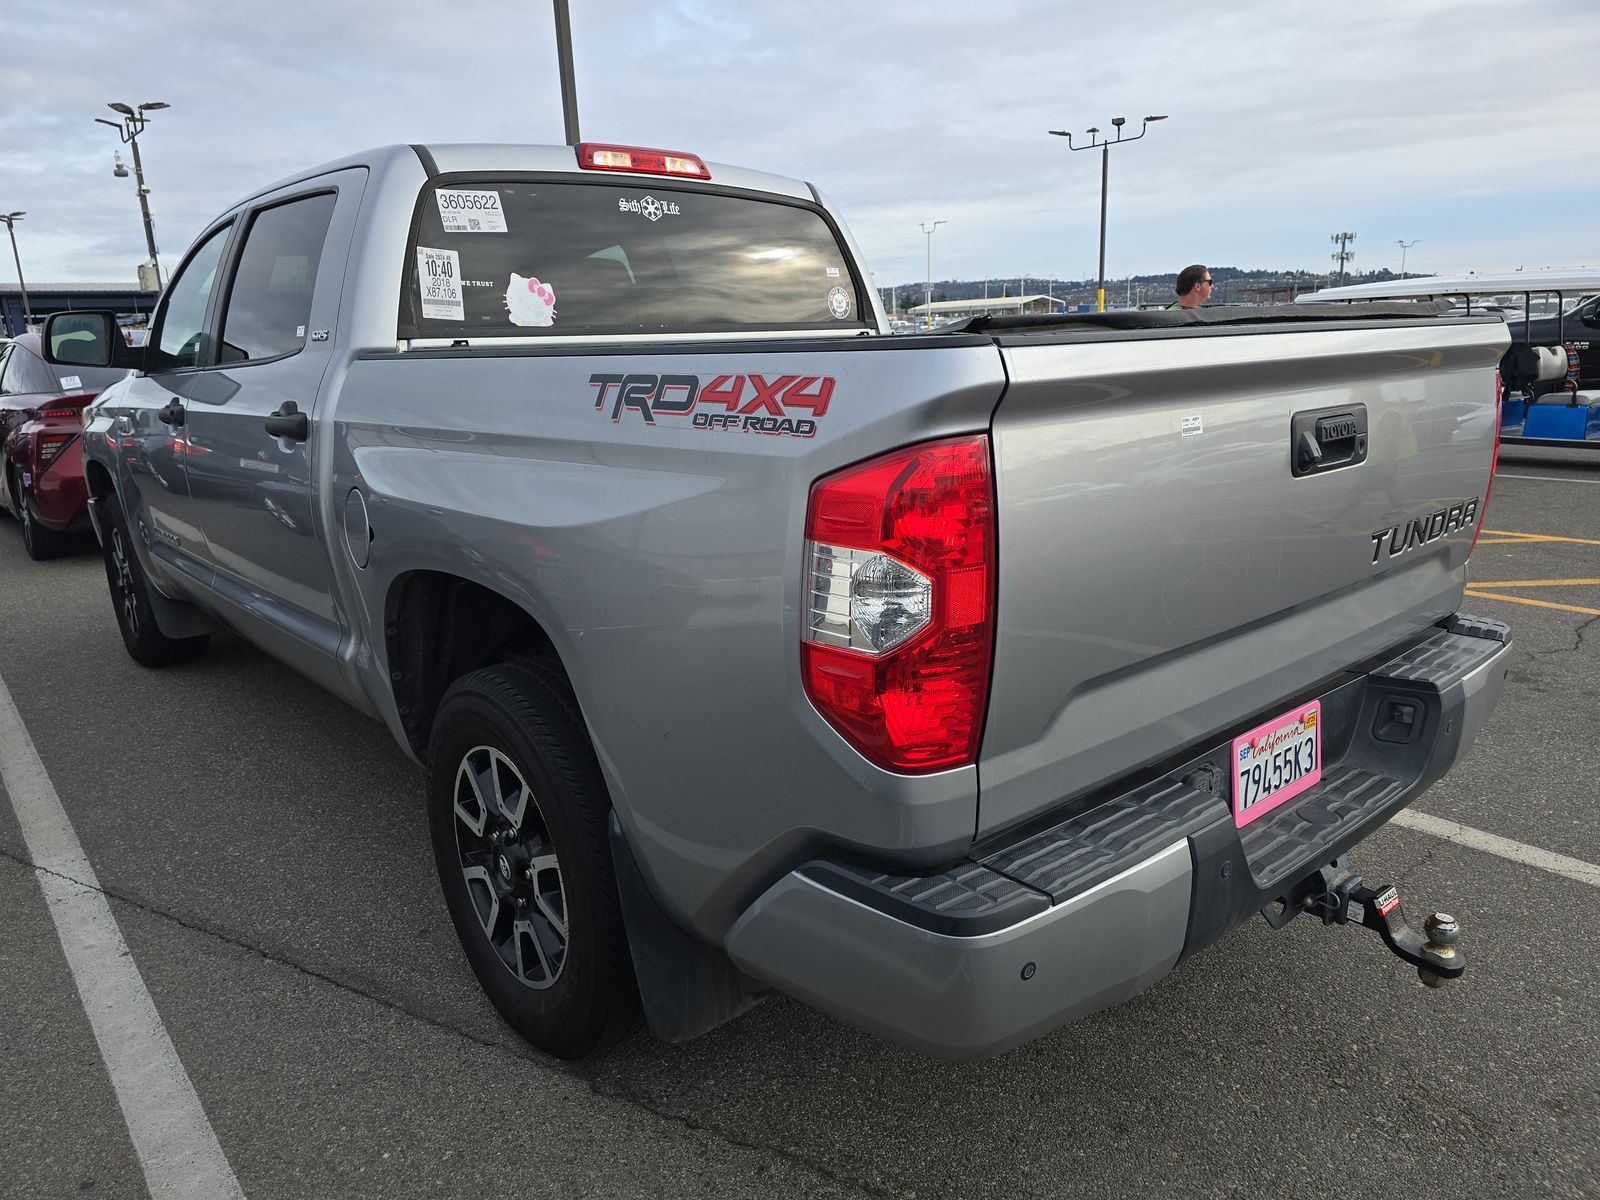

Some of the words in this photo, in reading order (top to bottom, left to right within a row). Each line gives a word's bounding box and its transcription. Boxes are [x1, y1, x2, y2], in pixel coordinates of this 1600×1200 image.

[440, 194, 499, 210] 3605622
[619, 197, 641, 215] Sith
[660, 200, 680, 215] Life
[442, 215, 458, 223] DLR
[425, 259, 453, 278] 10:40
[432, 277, 451, 288] 2018
[426, 286, 457, 299] X87,106
[589, 373, 700, 427] TRD
[698, 374, 836, 418] 4X4
[692, 412, 741, 431] OFF
[742, 415, 818, 439] ROAD
[1323, 421, 1357, 440] TOYOTA
[1371, 496, 1480, 566] TUNDRA
[1252, 723, 1305, 759] California
[1240, 746, 1251, 761] SEP
[1240, 737, 1314, 809] 79455K3
